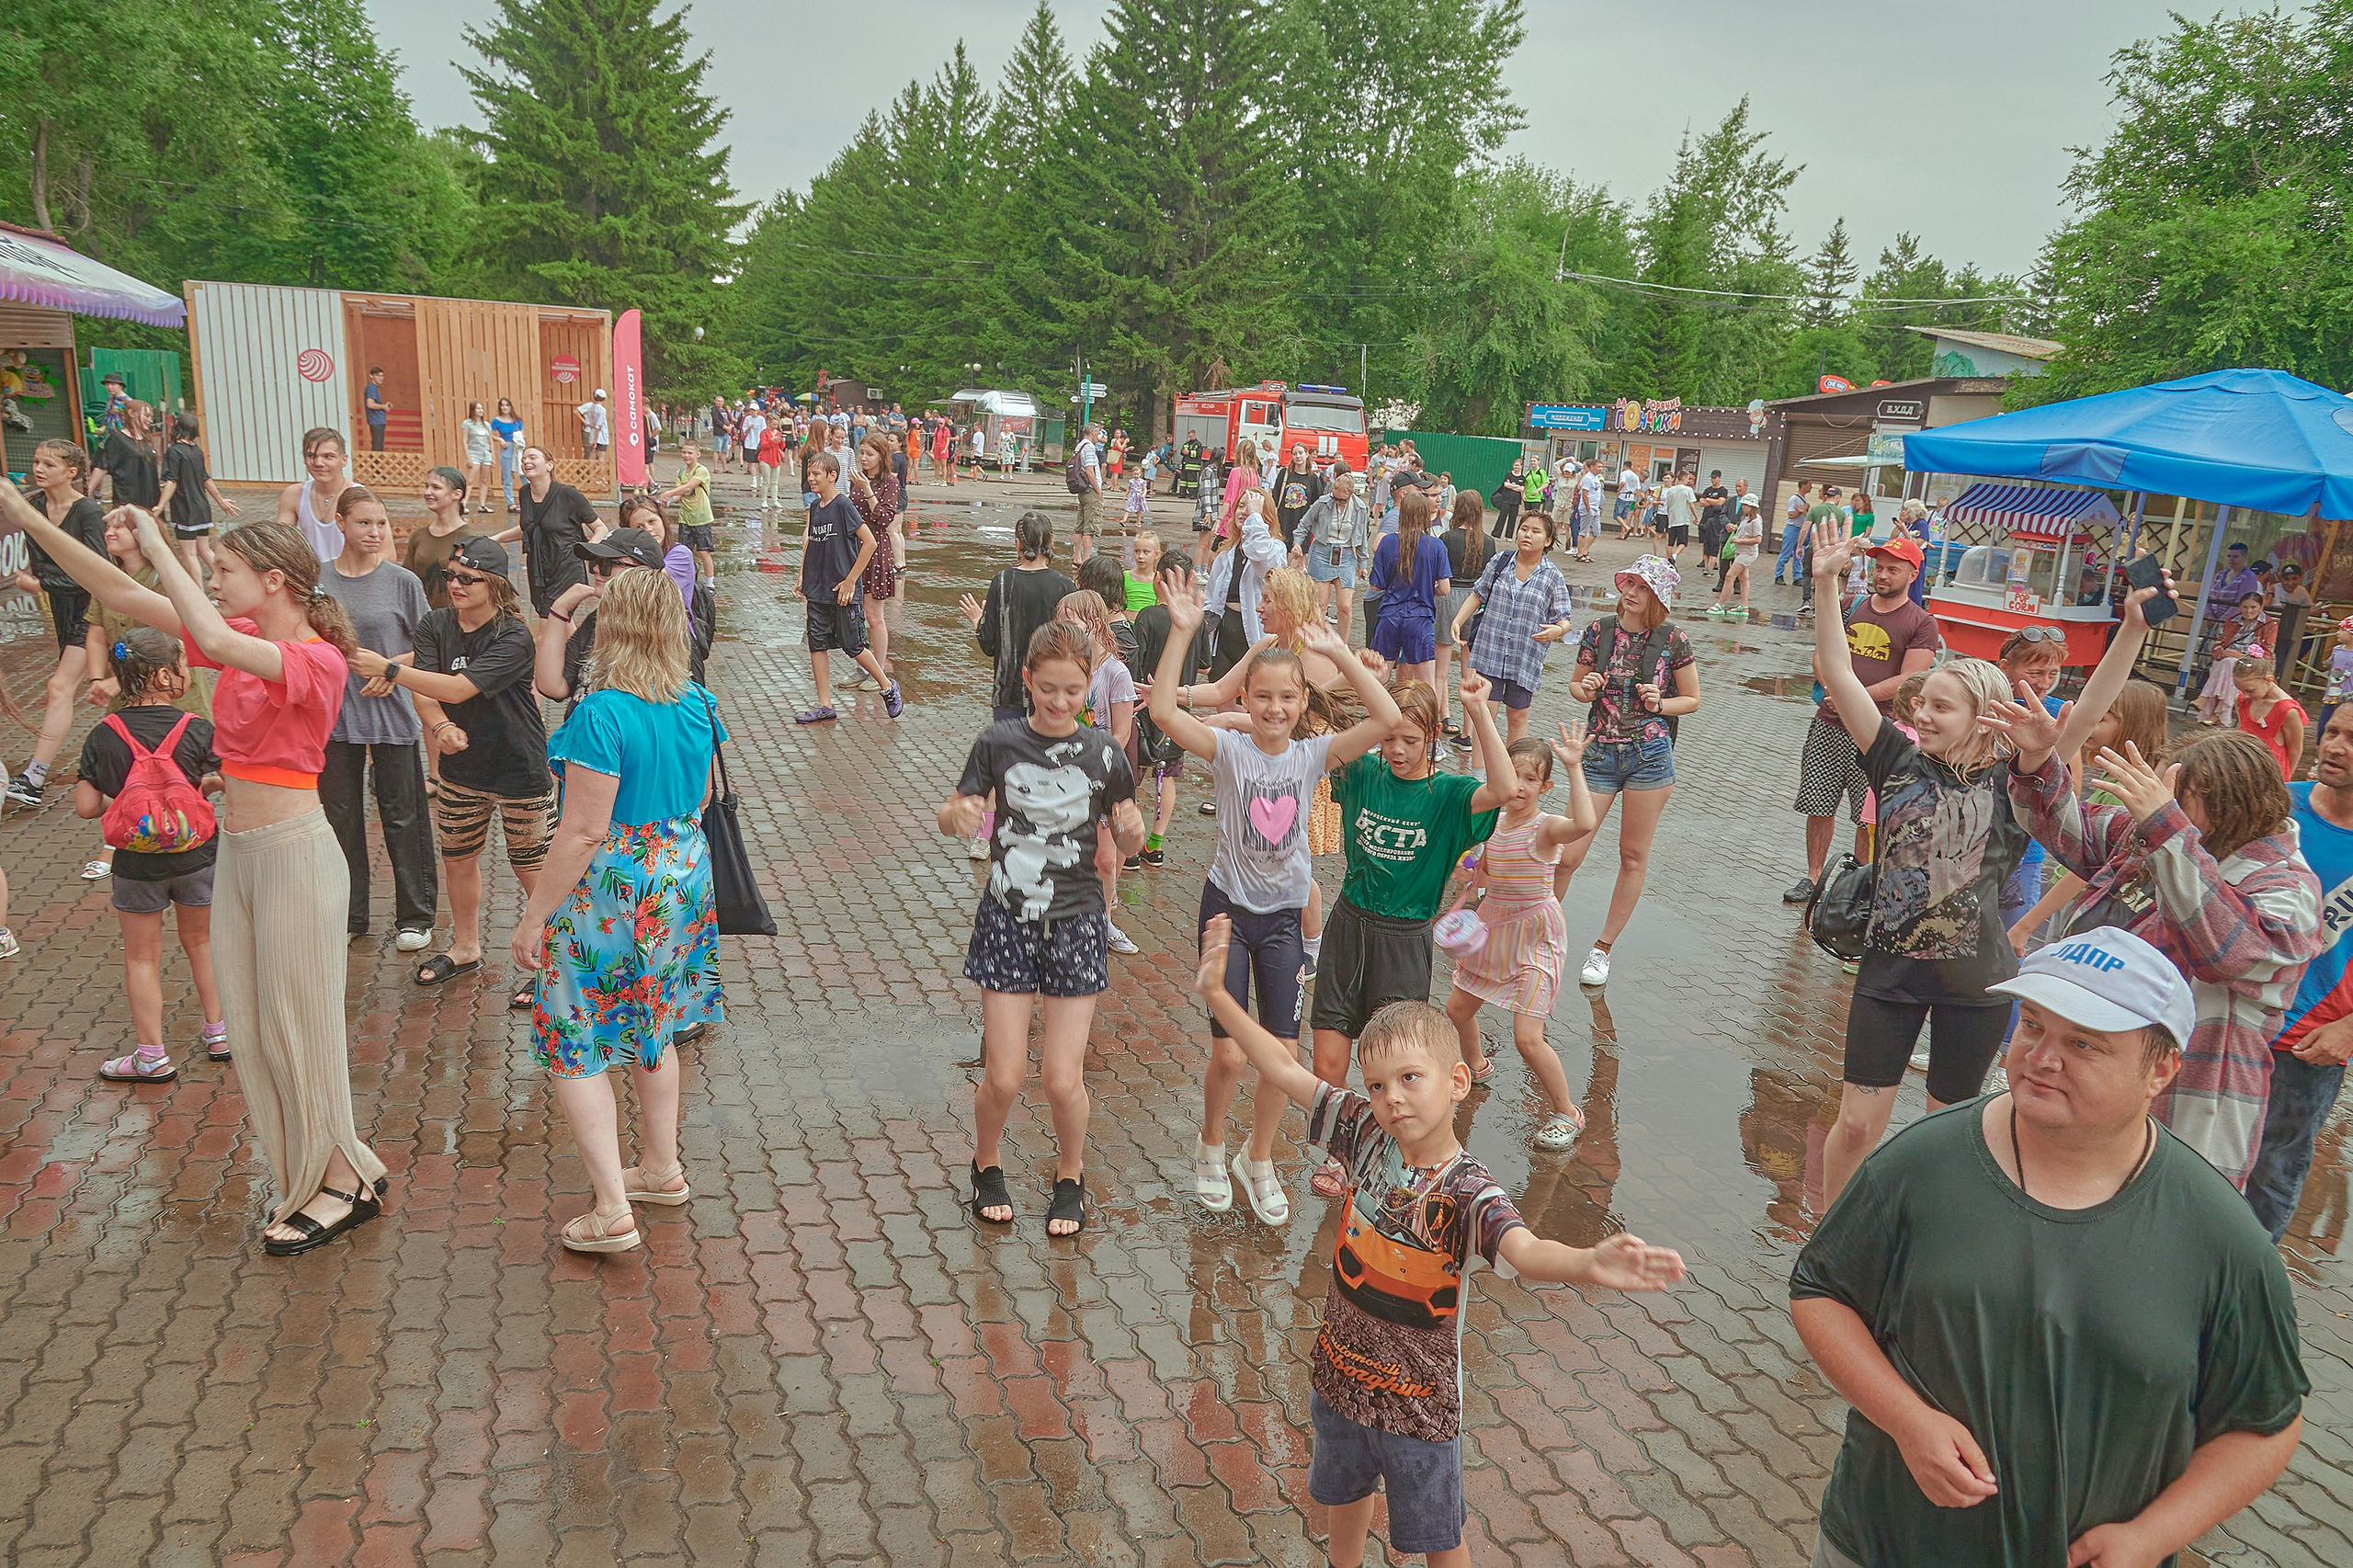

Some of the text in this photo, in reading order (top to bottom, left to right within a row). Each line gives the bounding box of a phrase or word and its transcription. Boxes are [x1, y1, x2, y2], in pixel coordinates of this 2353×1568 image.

[1645, 396, 1680, 412] ГОРЯЧИЕ
[1886, 405, 1914, 415] ВХОД
[1615, 401, 1681, 432] ПОНЧИКИ
[1253, 432, 1258, 441] 1
[2015, 593, 2029, 602] POP
[2008, 600, 2035, 612] CORN
[2050, 944, 2125, 972] ЛДПР
